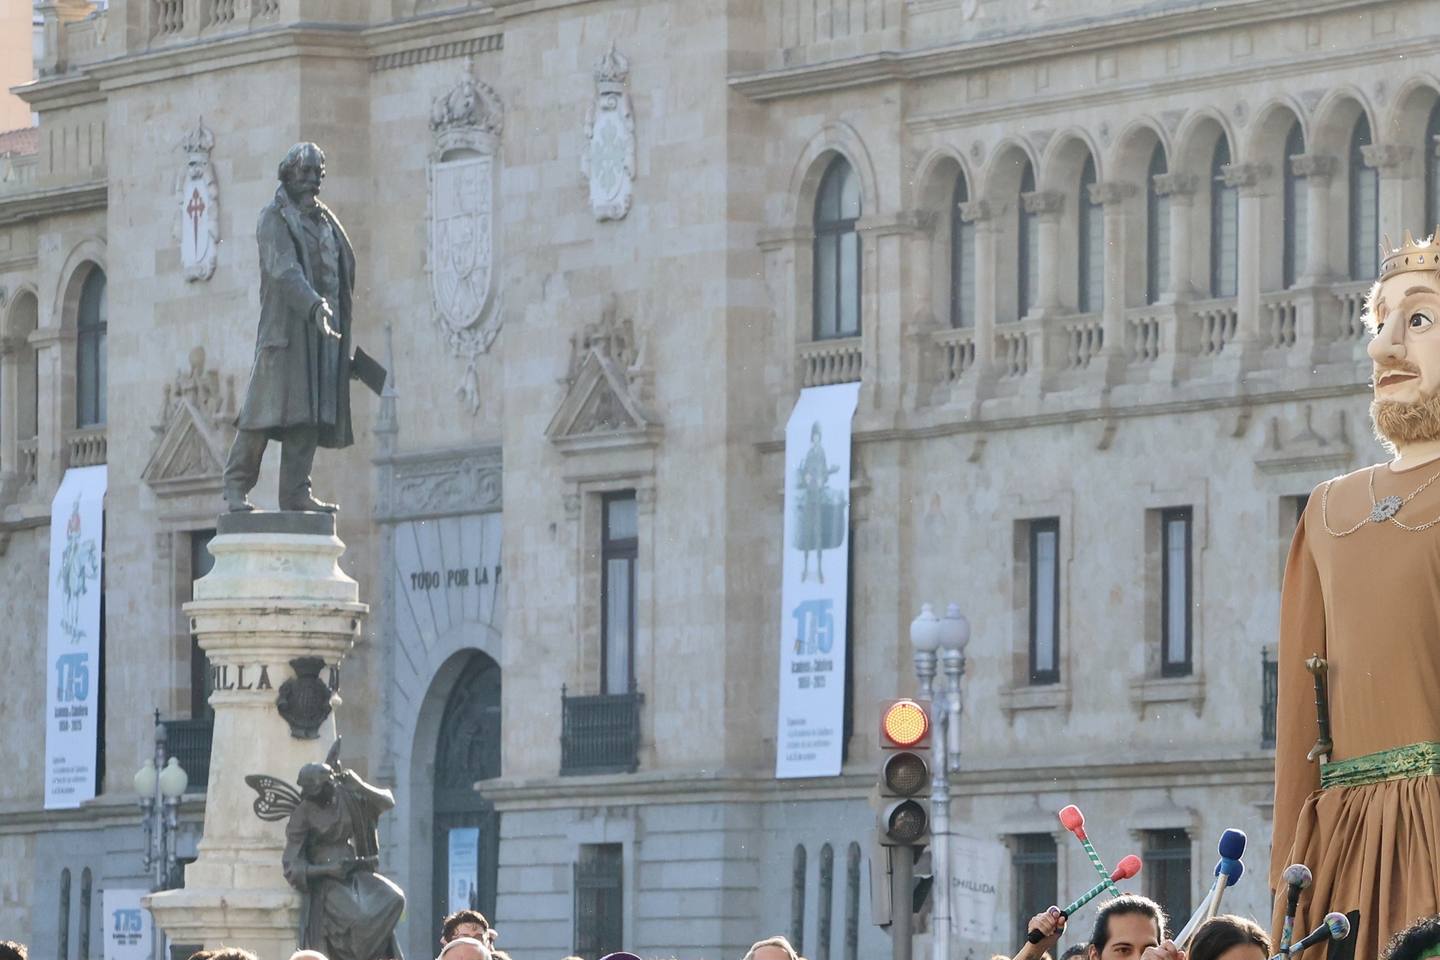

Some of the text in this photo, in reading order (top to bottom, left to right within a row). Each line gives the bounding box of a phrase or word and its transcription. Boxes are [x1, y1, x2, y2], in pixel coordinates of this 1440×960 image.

[410, 571, 440, 591] TODO
[447, 568, 469, 588] POR
[474, 567, 489, 585] LA
[791, 598, 833, 656] 175
[56, 652, 89, 702] 175
[213, 664, 272, 690] ILLA
[112, 908, 142, 932] 175
